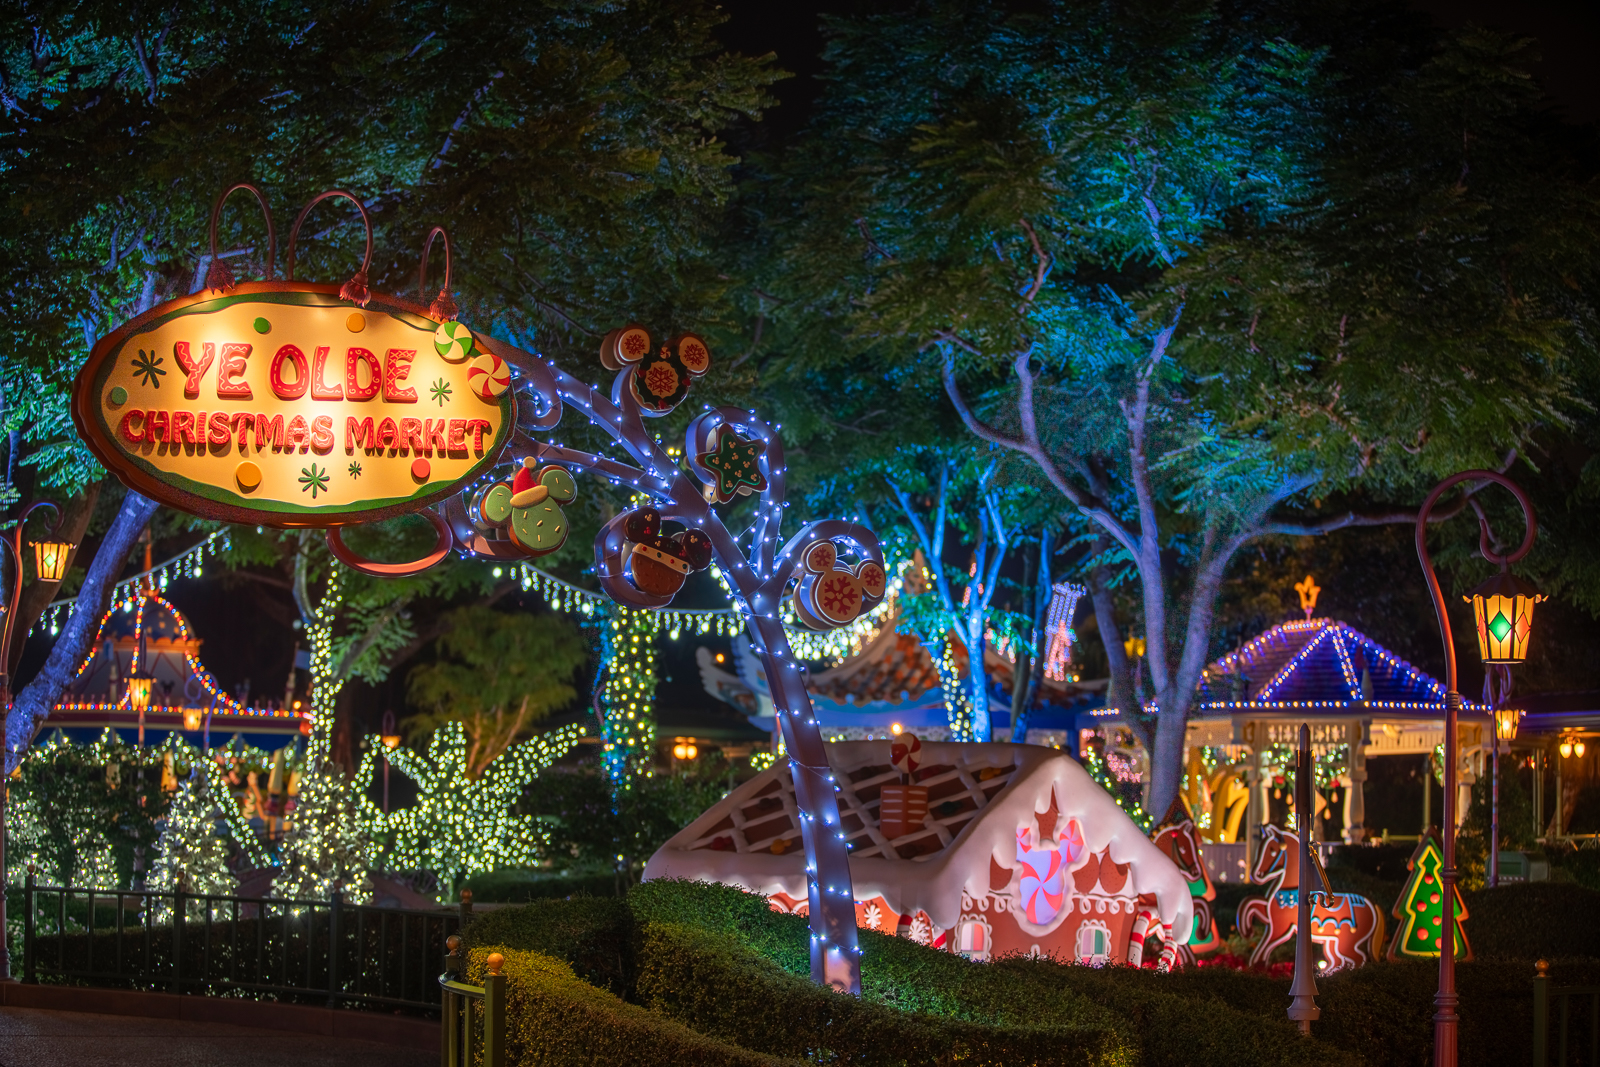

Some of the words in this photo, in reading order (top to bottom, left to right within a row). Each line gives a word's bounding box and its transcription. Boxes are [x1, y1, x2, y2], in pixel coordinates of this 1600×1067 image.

[175, 341, 254, 400] YE
[268, 344, 418, 404] OLDE
[121, 409, 334, 451] CHRISTMAS
[345, 416, 492, 454] MARKET
